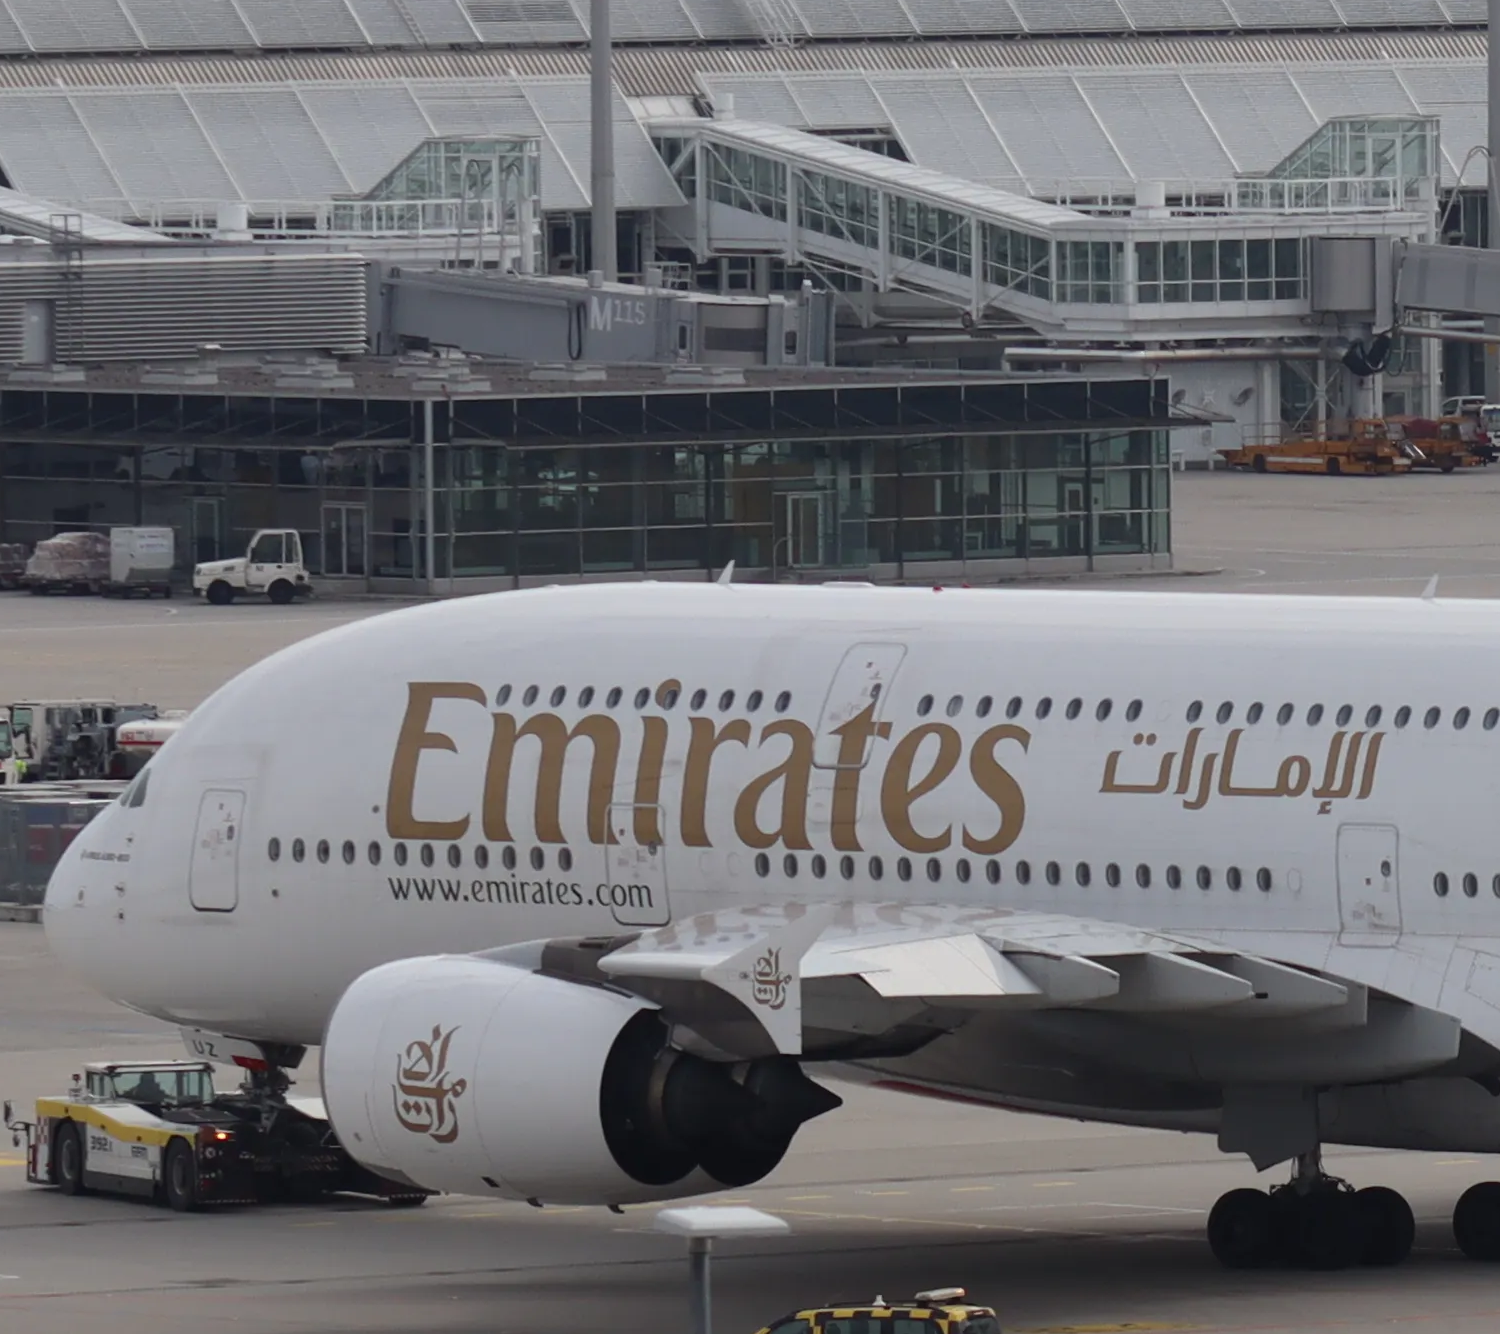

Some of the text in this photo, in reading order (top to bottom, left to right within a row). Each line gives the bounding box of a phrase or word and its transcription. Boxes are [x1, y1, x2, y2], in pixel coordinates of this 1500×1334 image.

[590, 295, 646, 332] M115
[386, 679, 1031, 855] Emirates
[1099, 727, 1387, 815] الإمارات
[388, 873, 654, 908] www.emirates.com
[192, 1039, 219, 1058] UZ
